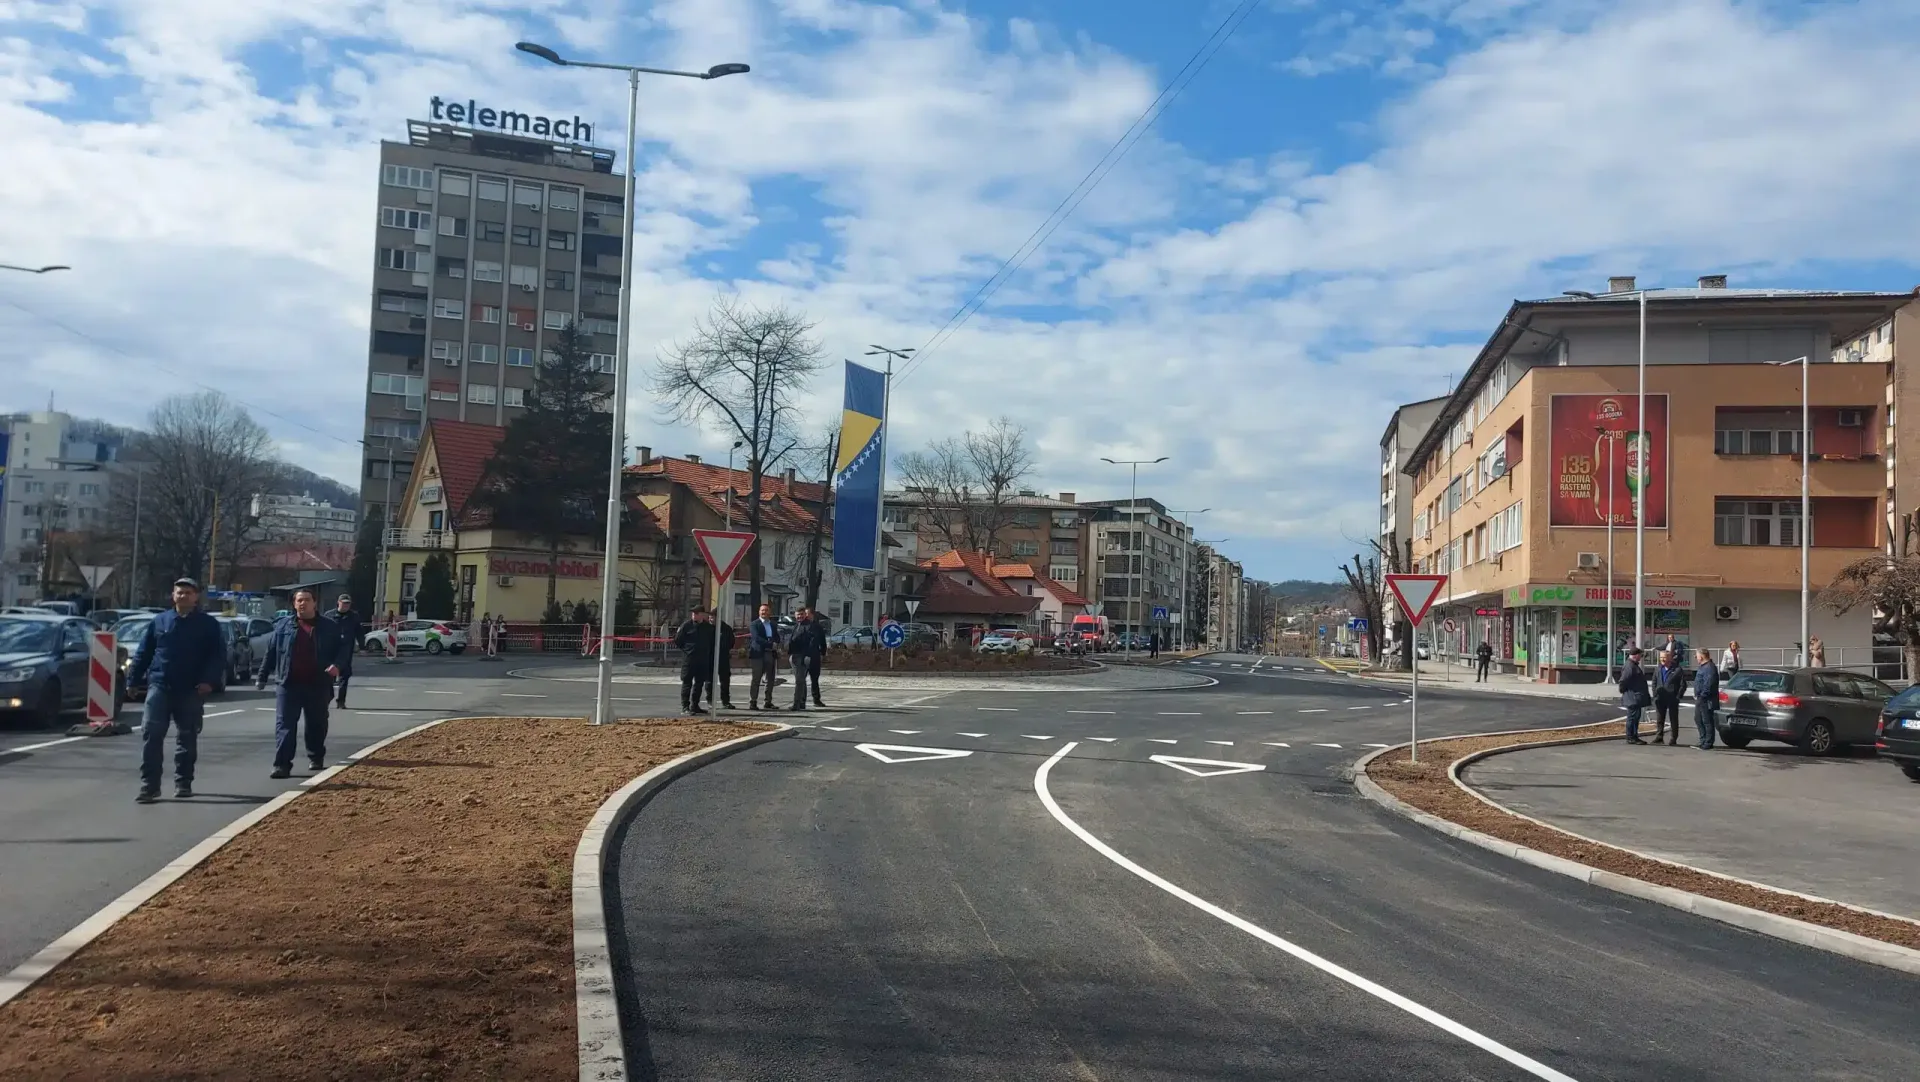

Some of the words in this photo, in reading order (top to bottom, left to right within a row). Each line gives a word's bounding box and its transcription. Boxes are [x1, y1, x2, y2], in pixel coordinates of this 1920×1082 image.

[431, 96, 591, 142] telemach
[1561, 455, 1590, 474] 135
[1560, 474, 1591, 483] GODINA
[1560, 483, 1591, 491] RASTEMO
[1560, 491, 1569, 499] SA
[1570, 491, 1591, 499] VAMA
[1604, 513, 1625, 523] 184
[1585, 587, 1633, 600] FRIENDS
[1666, 599, 1691, 607] CANIN
